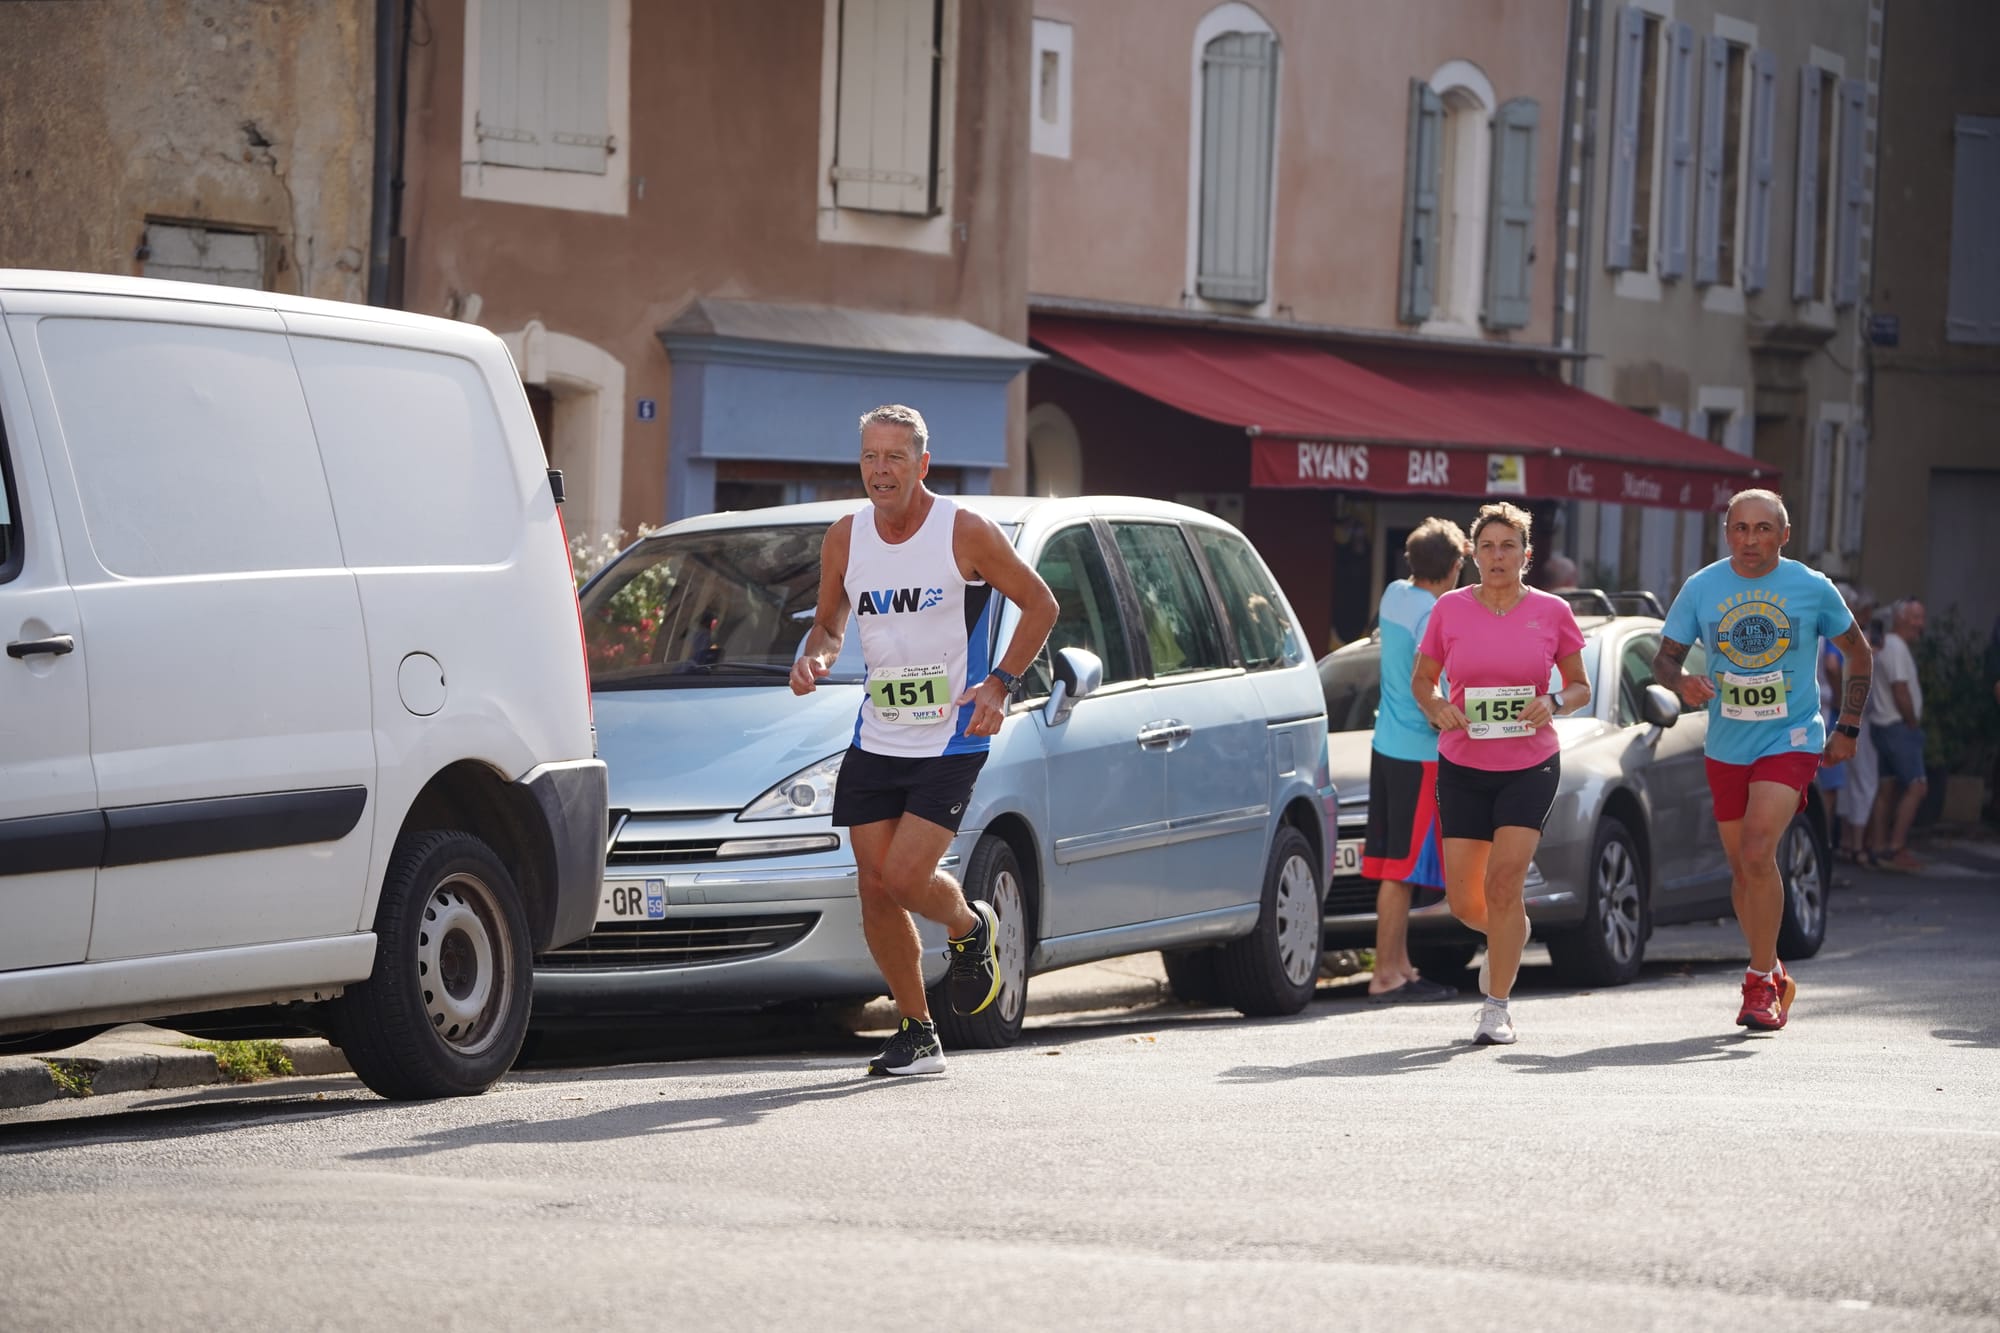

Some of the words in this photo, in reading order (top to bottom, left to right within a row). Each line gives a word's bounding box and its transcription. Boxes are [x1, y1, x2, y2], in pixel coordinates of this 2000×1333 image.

[1298, 442, 1369, 480] RYAN'S
[1407, 450, 1449, 485] BAR
[858, 587, 922, 616] AVW
[1717, 589, 1788, 613] OFFICIAL
[881, 680, 935, 706] 151
[1729, 686, 1777, 706] 109
[1475, 699, 1525, 721] 155
[648, 899, 663, 913] 59
